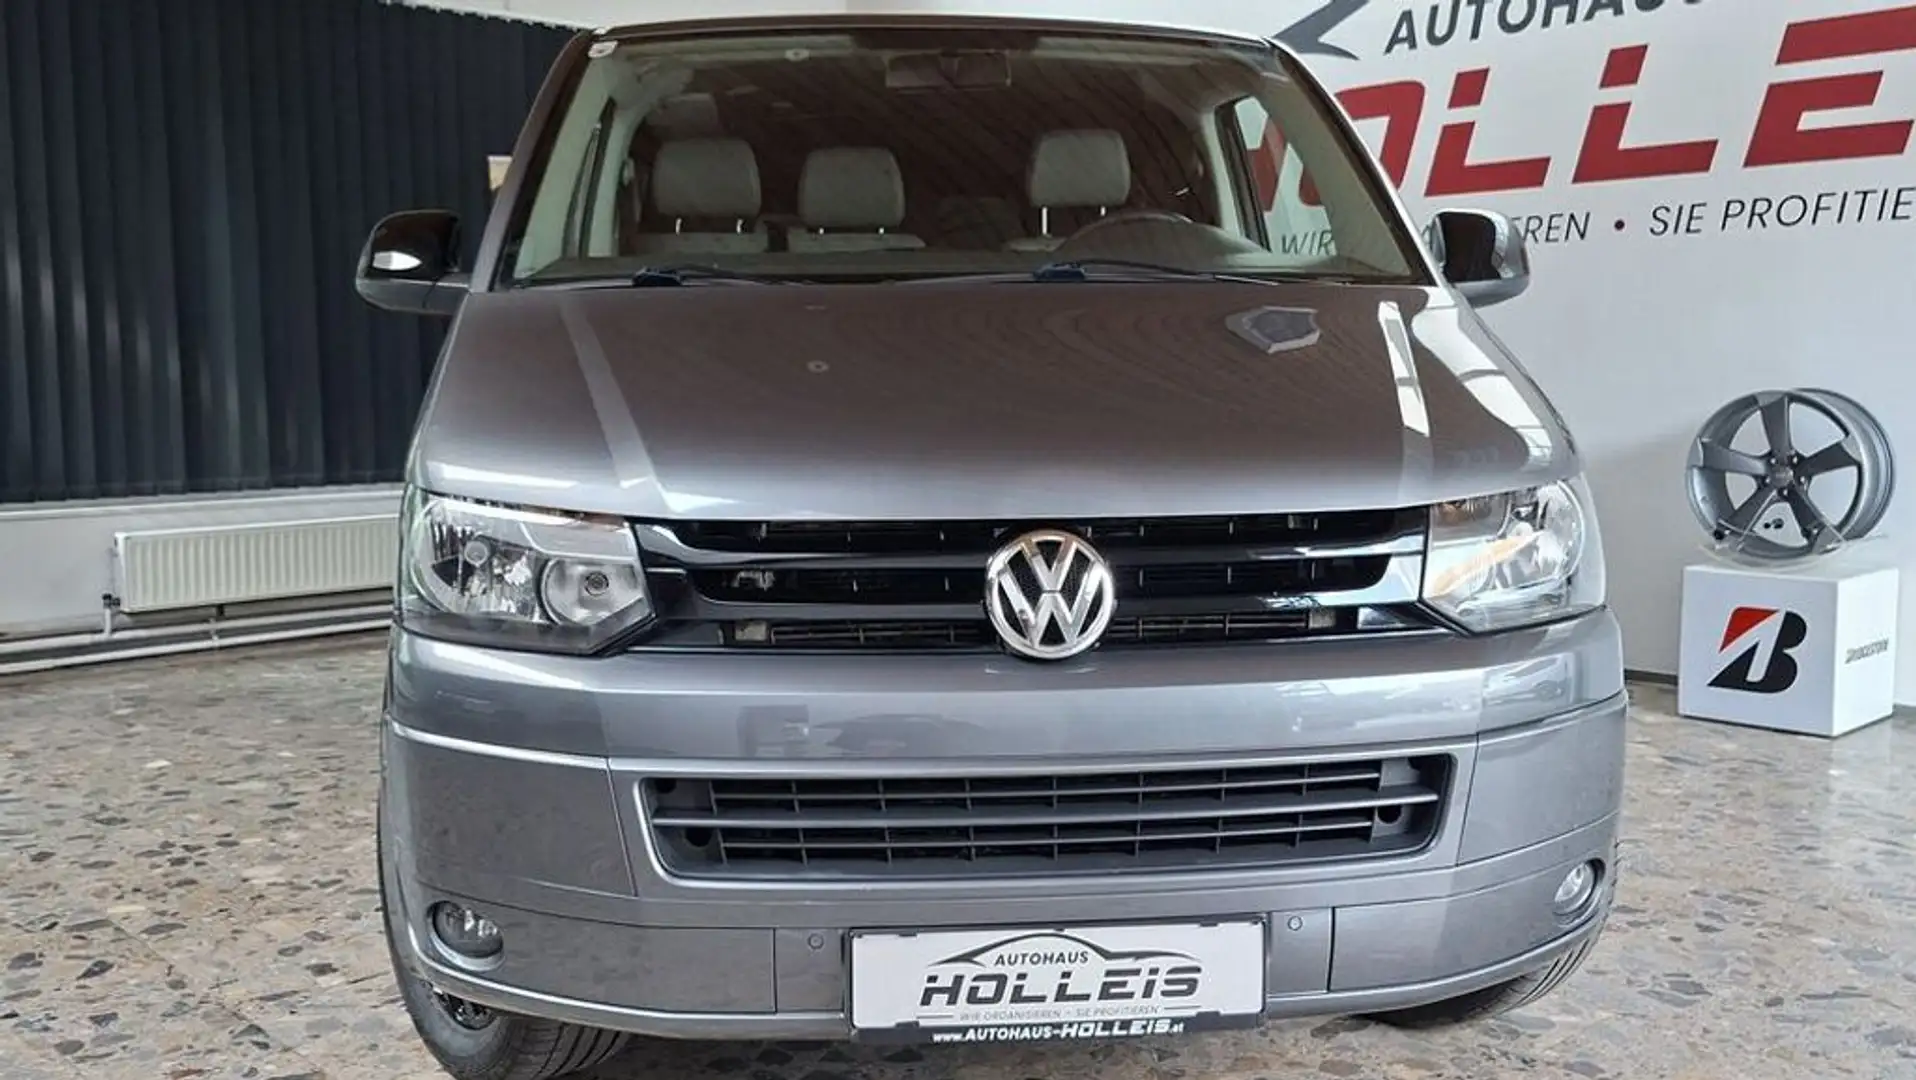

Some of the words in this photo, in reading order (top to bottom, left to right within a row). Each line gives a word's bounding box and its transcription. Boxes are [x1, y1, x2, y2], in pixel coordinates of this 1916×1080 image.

[1650, 203, 1708, 237] SIE
[1721, 187, 1916, 232] PROFITIE
[993, 950, 1089, 967] AUTOHAUS
